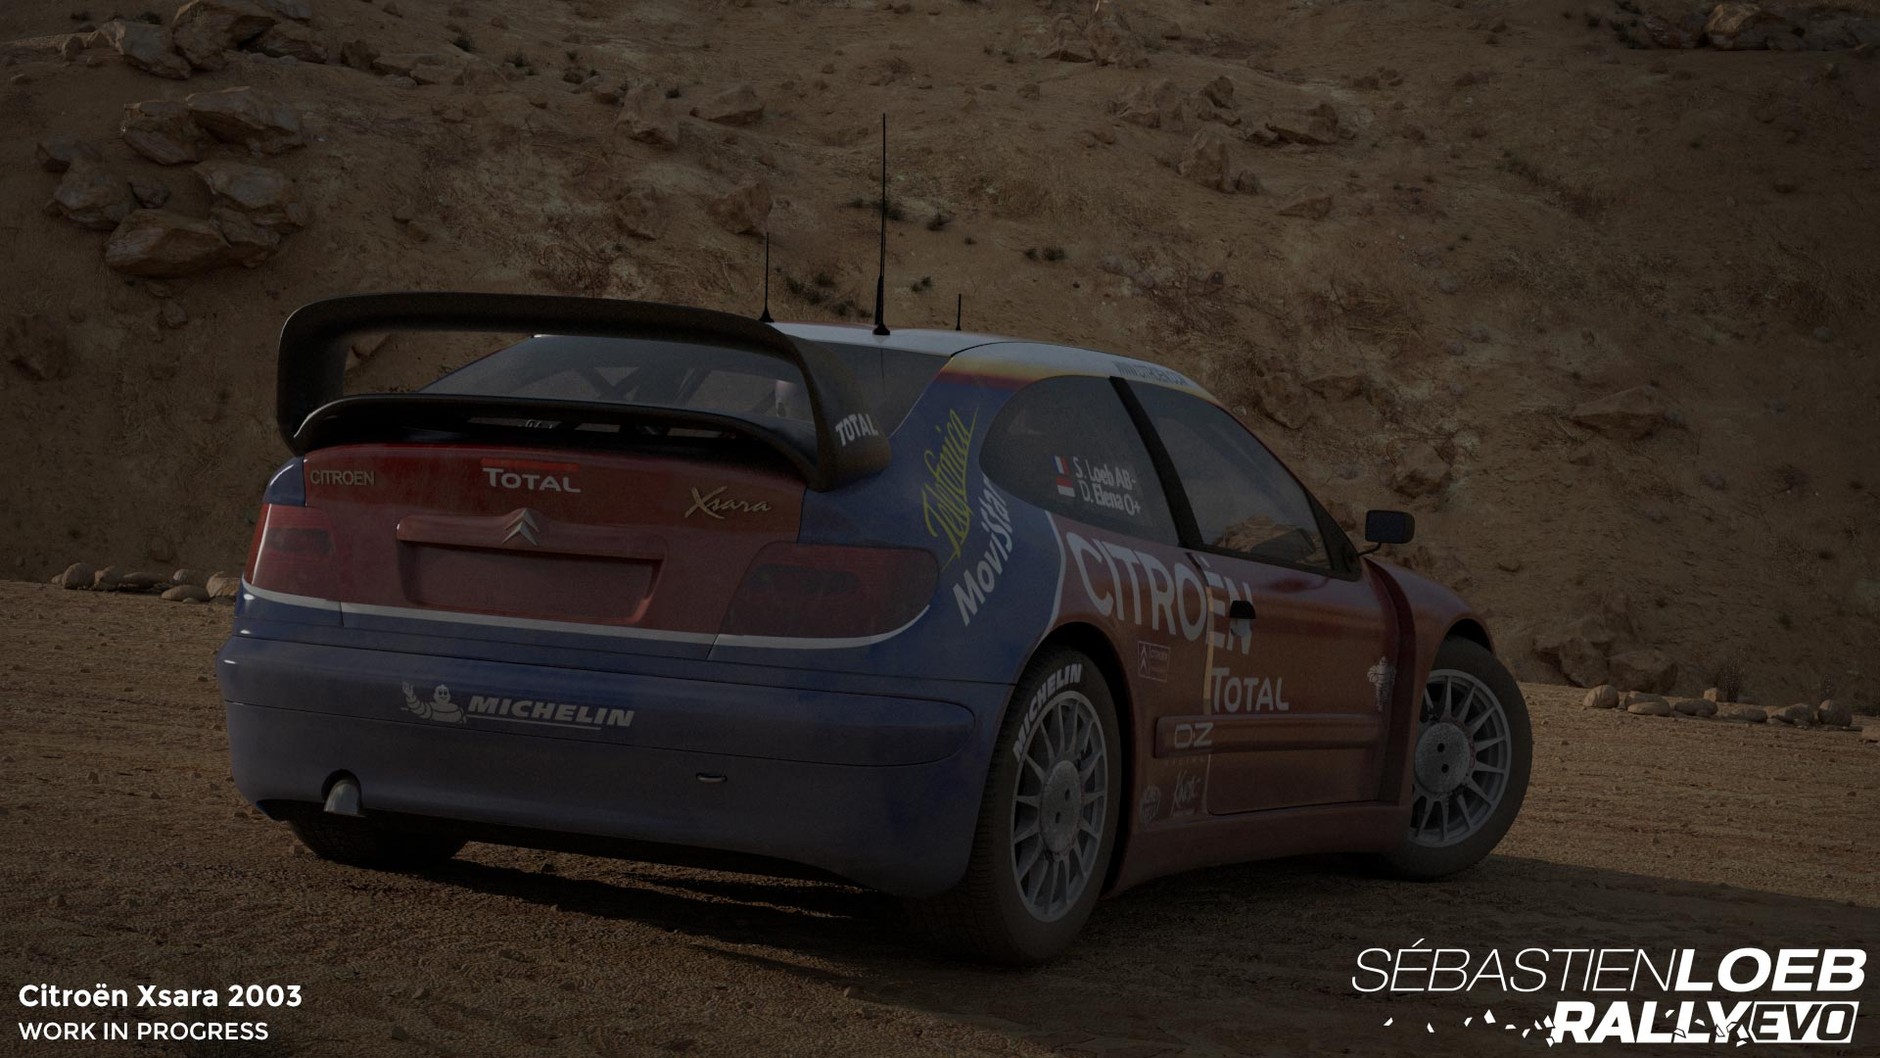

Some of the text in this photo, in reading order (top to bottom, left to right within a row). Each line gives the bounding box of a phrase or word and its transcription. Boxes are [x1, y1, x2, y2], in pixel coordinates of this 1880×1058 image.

[835, 413, 879, 447] TOTAL
[482, 467, 581, 494] TOTAL
[684, 486, 771, 519] Xsara
[1211, 667, 1290, 713] TOTAL
[467, 695, 634, 728] MICHELIN
[1012, 663, 1082, 763] MICHELIN
